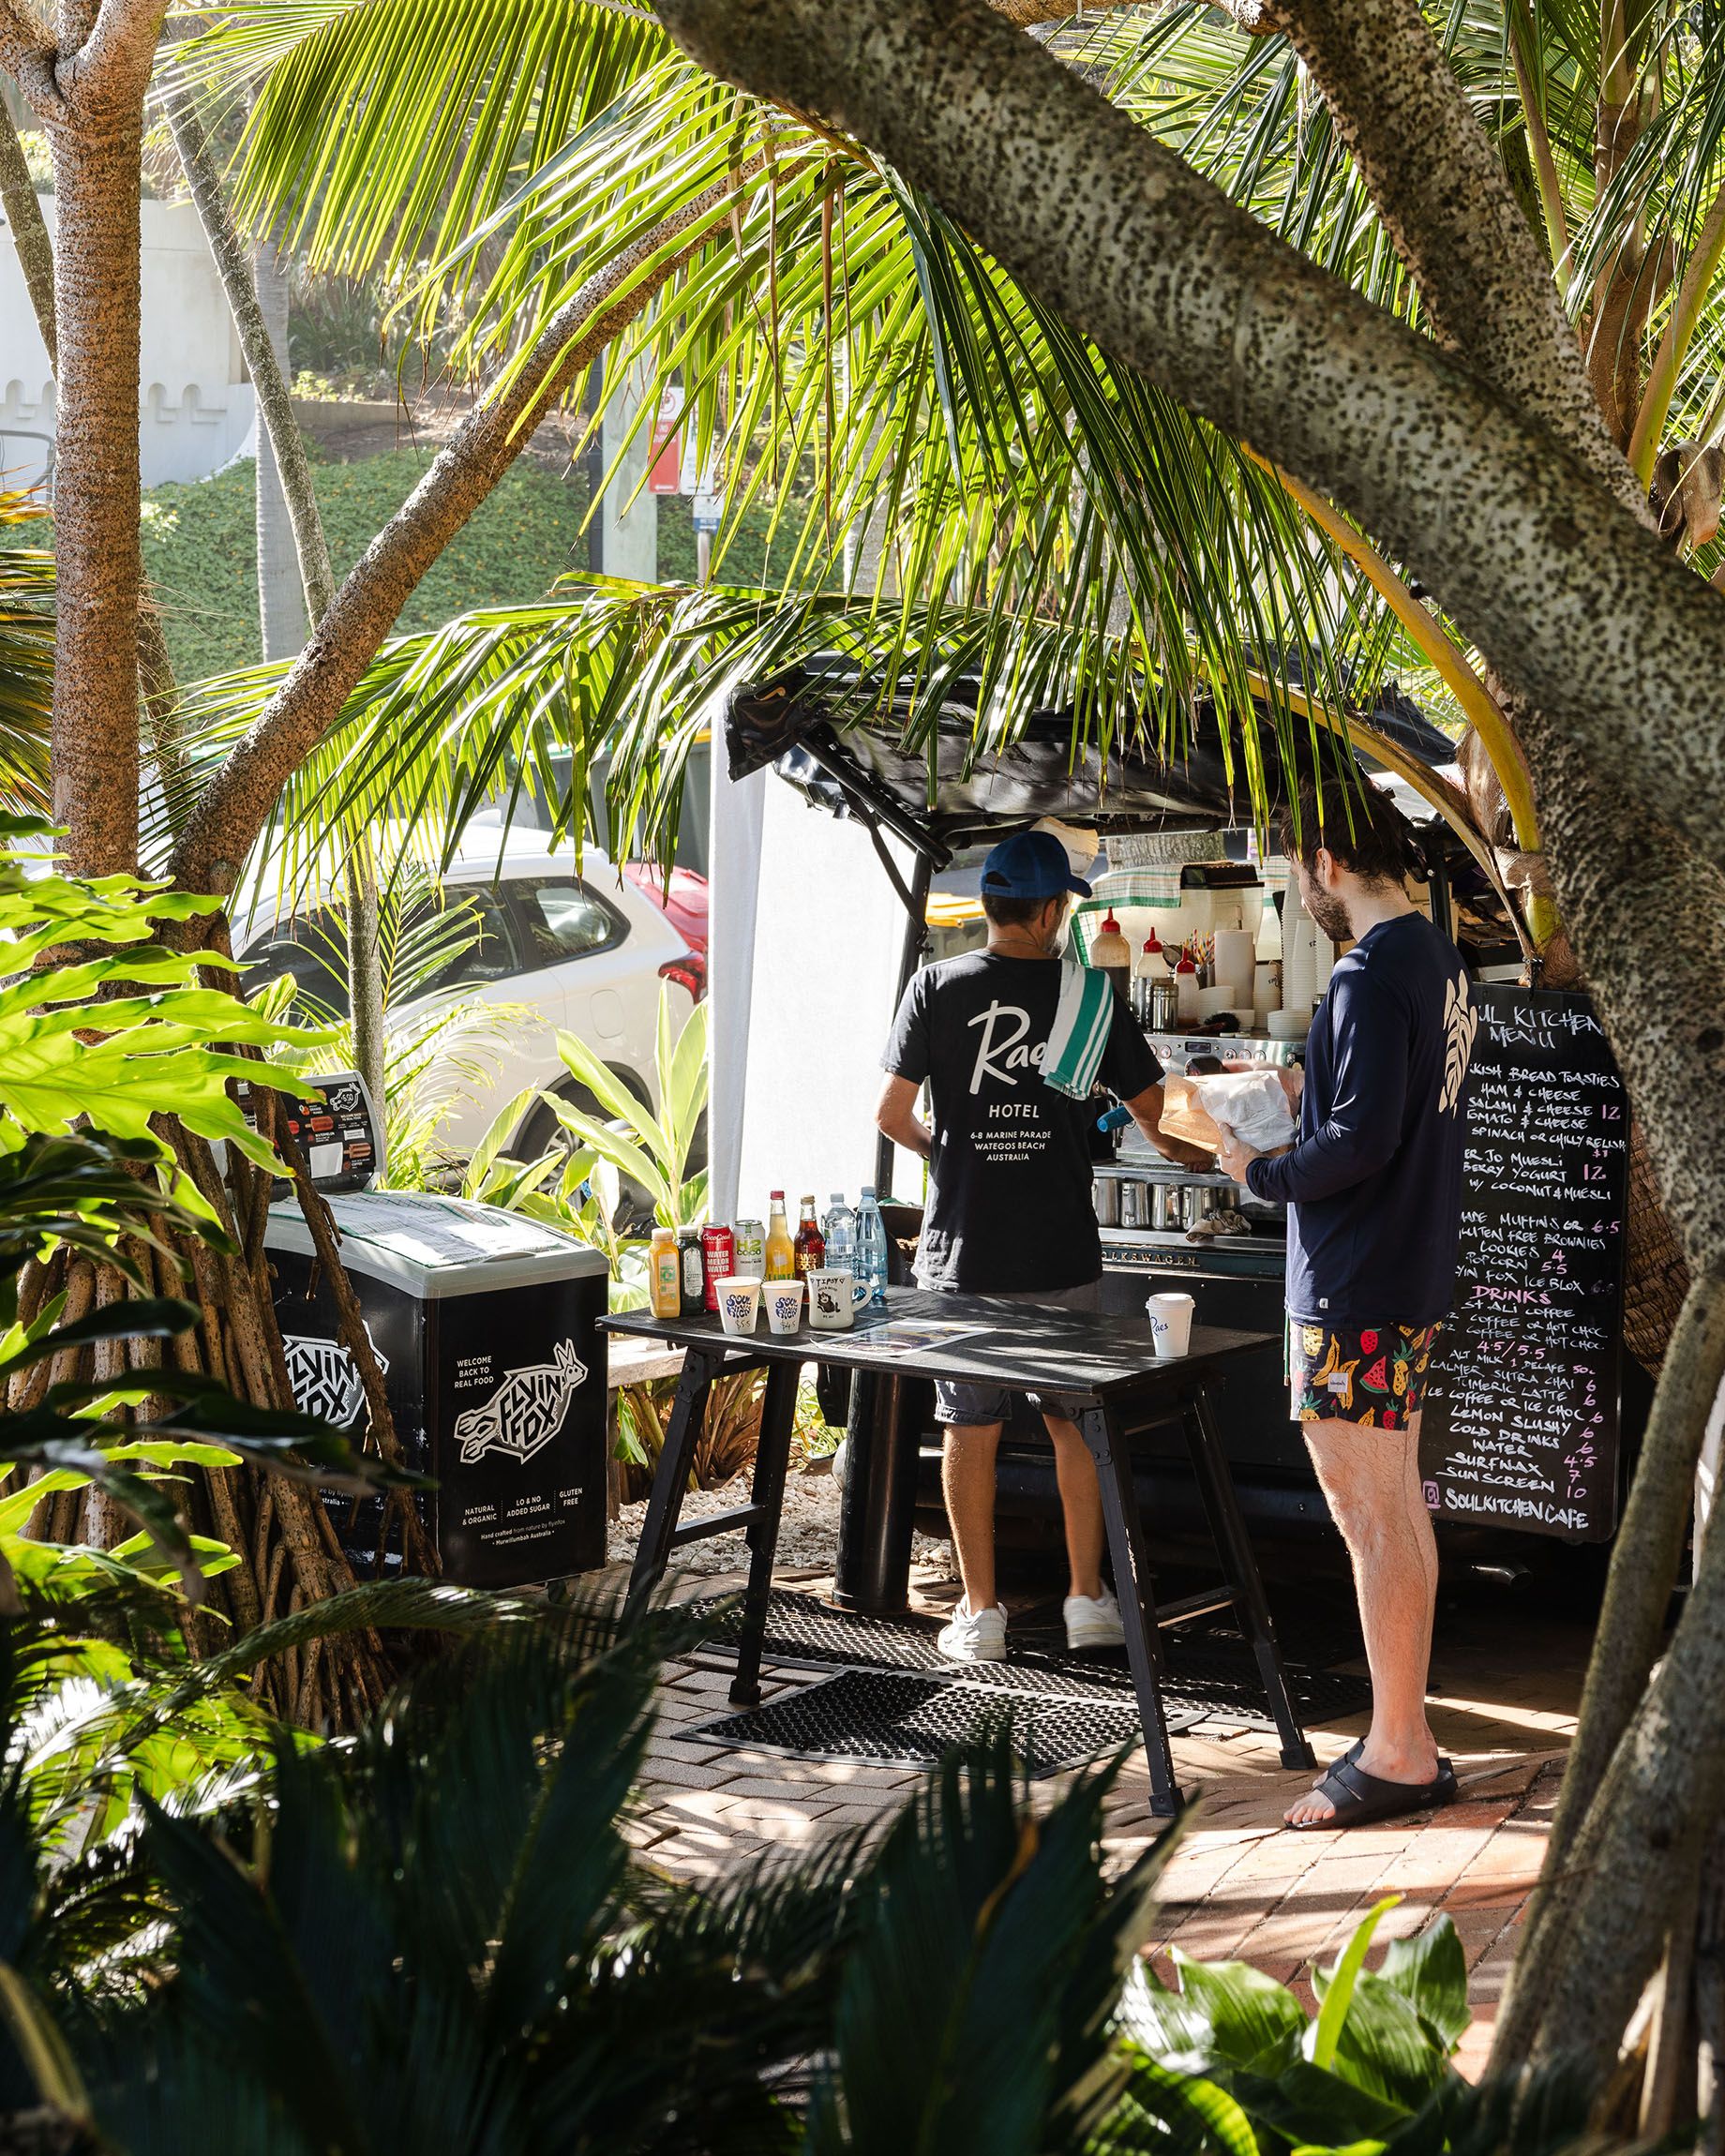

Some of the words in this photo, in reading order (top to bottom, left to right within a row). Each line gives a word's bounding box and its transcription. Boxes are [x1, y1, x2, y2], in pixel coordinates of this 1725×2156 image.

[1514, 1006, 1604, 1036] KITCHEN
[1489, 1026, 1555, 1049] MENU
[968, 999, 1048, 1095] Rae
[1508, 1067, 1556, 1083] BREAD
[1480, 1083, 1508, 1100] HAM
[1528, 1086, 1582, 1103] CHEESE
[988, 1103, 1040, 1118] HOTEL
[1467, 1097, 1517, 1114] SALAMI
[1537, 1103, 1593, 1116] CHEESE
[1601, 1104, 1621, 1120] 12
[1535, 1117, 1589, 1130] CHEESE
[970, 1131, 983, 1140] 6-8
[1020, 1130, 1052, 1139] PARADE
[1471, 1127, 1525, 1143] SPINACH
[1529, 1132, 1547, 1143] OR
[1549, 1132, 1585, 1149] CHILLY
[975, 1142, 1015, 1150] WATEGOS
[1017, 1142, 1045, 1150] BEACH
[986, 1153, 1029, 1161] AUSTRALIA
[1511, 1166, 1567, 1183] YOGURT
[1583, 1163, 1607, 1181] 12
[1491, 1181, 1552, 1198] COCONUT
[1565, 1186, 1612, 1202] MUESLI
[1500, 1212, 1560, 1231] MUFFINS
[1591, 1219, 1621, 1235] 6.5
[1508, 1230, 1538, 1244] FREE
[1544, 1233, 1606, 1250] BROWNIES
[1102, 1251, 1196, 1265] OLKSWAGEN
[1479, 1239, 1540, 1259] COOKIES
[1552, 1249, 1566, 1264] 4
[1540, 1261, 1568, 1275] 5.5
[816, 1277, 839, 1287] TIPSY
[1485, 1269, 1519, 1284] FOX
[1524, 1275, 1546, 1288] ICE
[1544, 1278, 1585, 1295] BLOX
[1525, 1307, 1576, 1319] COFFEE
[1470, 1313, 1521, 1330] COFFEE
[1526, 1321, 1544, 1329] OR
[1546, 1323, 1568, 1336] HOT
[1571, 1325, 1609, 1339] CHOC
[1466, 1325, 1516, 1340] COFFEE
[1522, 1333, 1541, 1342] OR
[1545, 1336, 1569, 1349] HOT
[457, 1355, 492, 1368] WELCOME
[1448, 1349, 1471, 1360] ALT
[1477, 1354, 1503, 1365] MILK
[458, 1369, 478, 1378] BACK
[1430, 1359, 1485, 1378] CALMER
[1491, 1370, 1538, 1384] SUTRA
[1544, 1376, 1574, 1391] CHAI
[1585, 1379, 1597, 1393] 6
[454, 1380, 473, 1389] REAL
[473, 1376, 494, 1385] FOOD
[1521, 1386, 1568, 1401] LATTE
[1582, 1394, 1597, 1407] 6
[1448, 1389, 1494, 1408] COFFEE
[1500, 1397, 1522, 1410] OR
[1523, 1400, 1543, 1413] ICE
[1547, 1404, 1585, 1422] CHOC
[1589, 1411, 1604, 1425] 6
[510, 1395, 558, 1446] FOX
[1510, 1415, 1572, 1437] SLUSHY
[1579, 1427, 1595, 1439] 6
[1449, 1421, 1491, 1437] COLD
[1497, 1429, 1560, 1450] DRINKS
[1575, 1442, 1594, 1455] 6
[1472, 1439, 1534, 1459] WATER
[1563, 1455, 1598, 1469] 4.5
[1568, 1469, 1582, 1484] 7
[559, 1488, 583, 1499] GLUTEN
[1567, 1485, 1588, 1499] 10
[516, 1498, 525, 1506] LO
[532, 1495, 542, 1504] NO
[562, 1497, 578, 1506] FREE
[464, 1505, 495, 1516] NATURAL
[506, 1507, 529, 1518] ADDED
[530, 1503, 550, 1513] SUGAR
[468, 1513, 498, 1525] ORGANIC
[494, 1529, 513, 1537] crafted
[530, 1530, 551, 1539] Australia
